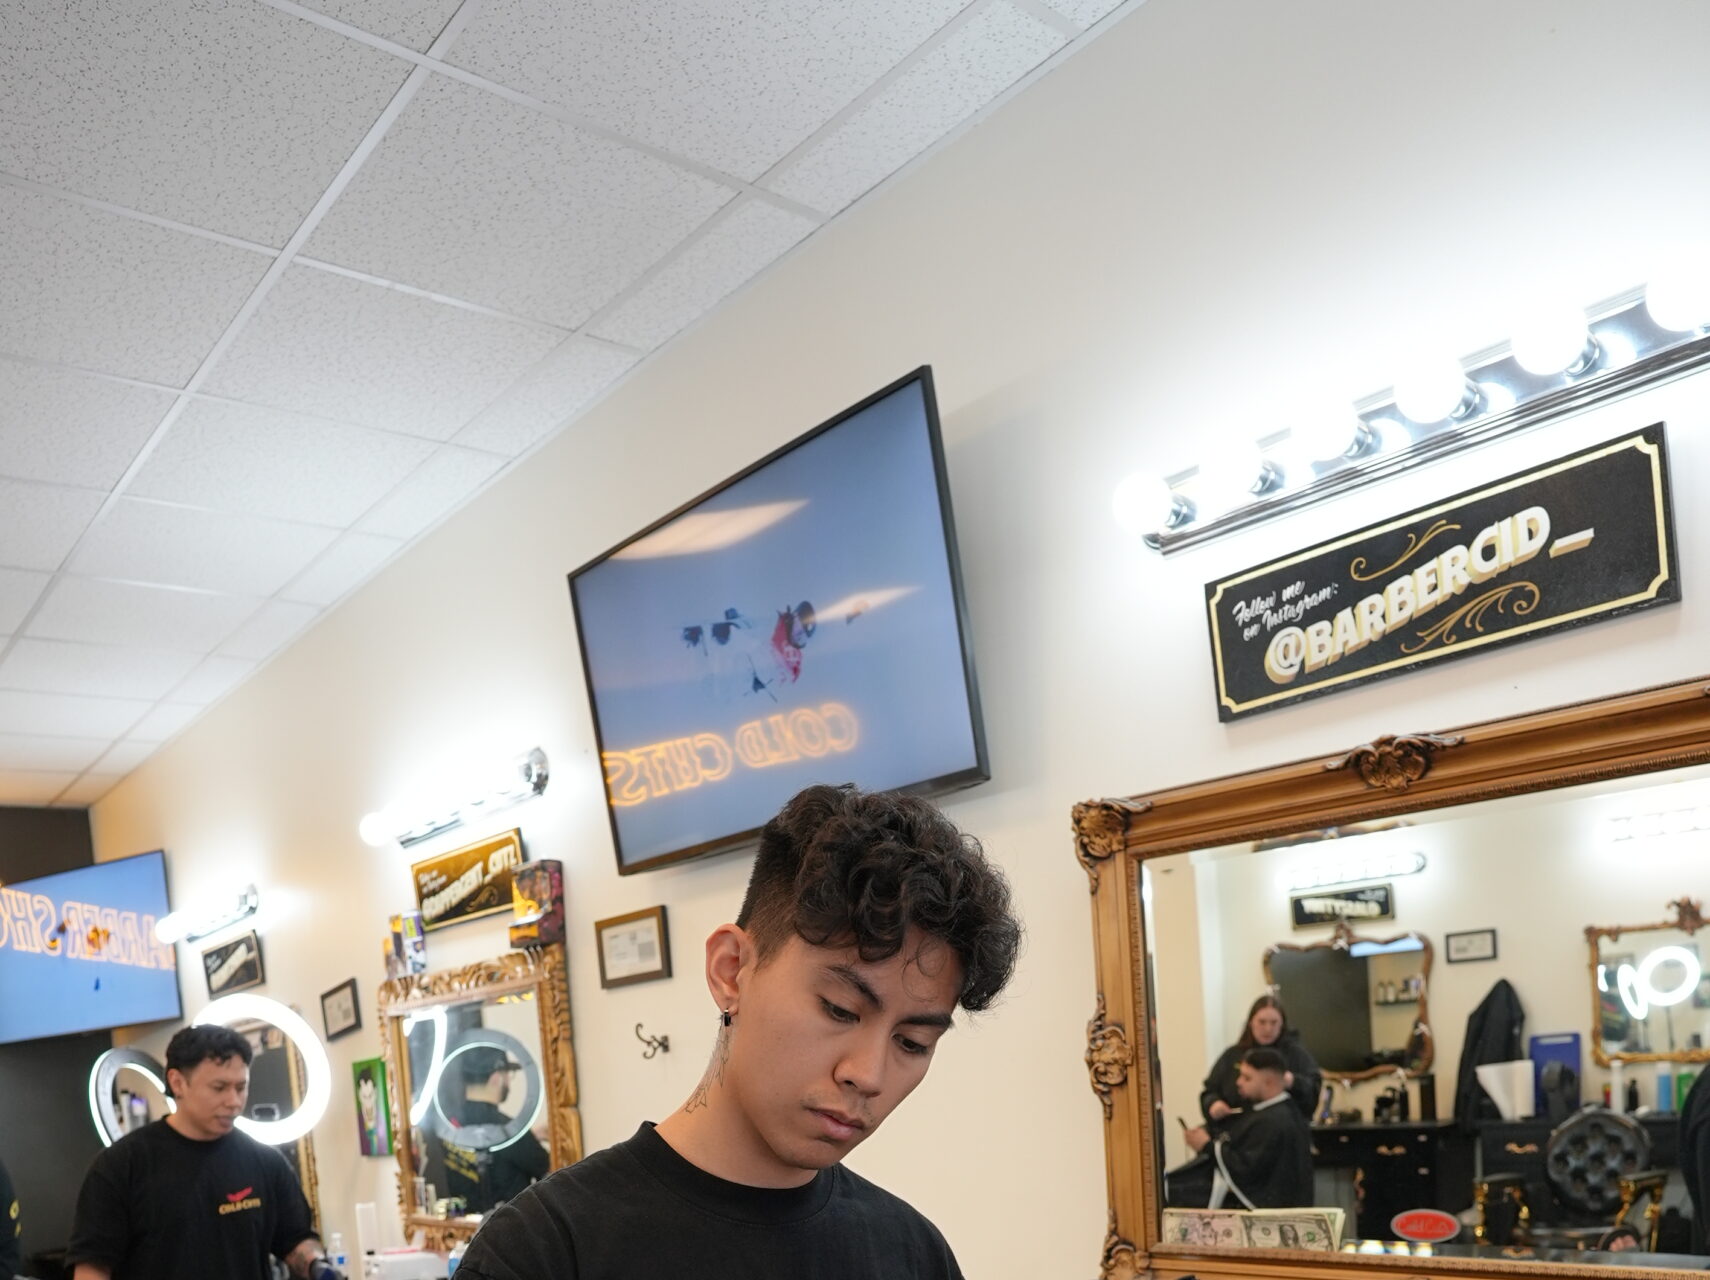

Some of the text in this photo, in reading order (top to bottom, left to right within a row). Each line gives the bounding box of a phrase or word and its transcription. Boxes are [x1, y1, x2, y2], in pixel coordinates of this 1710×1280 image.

[1232, 580, 1306, 627] Follow me
[1265, 505, 1595, 685] @BARBERCID_
[1243, 623, 1261, 642] on
